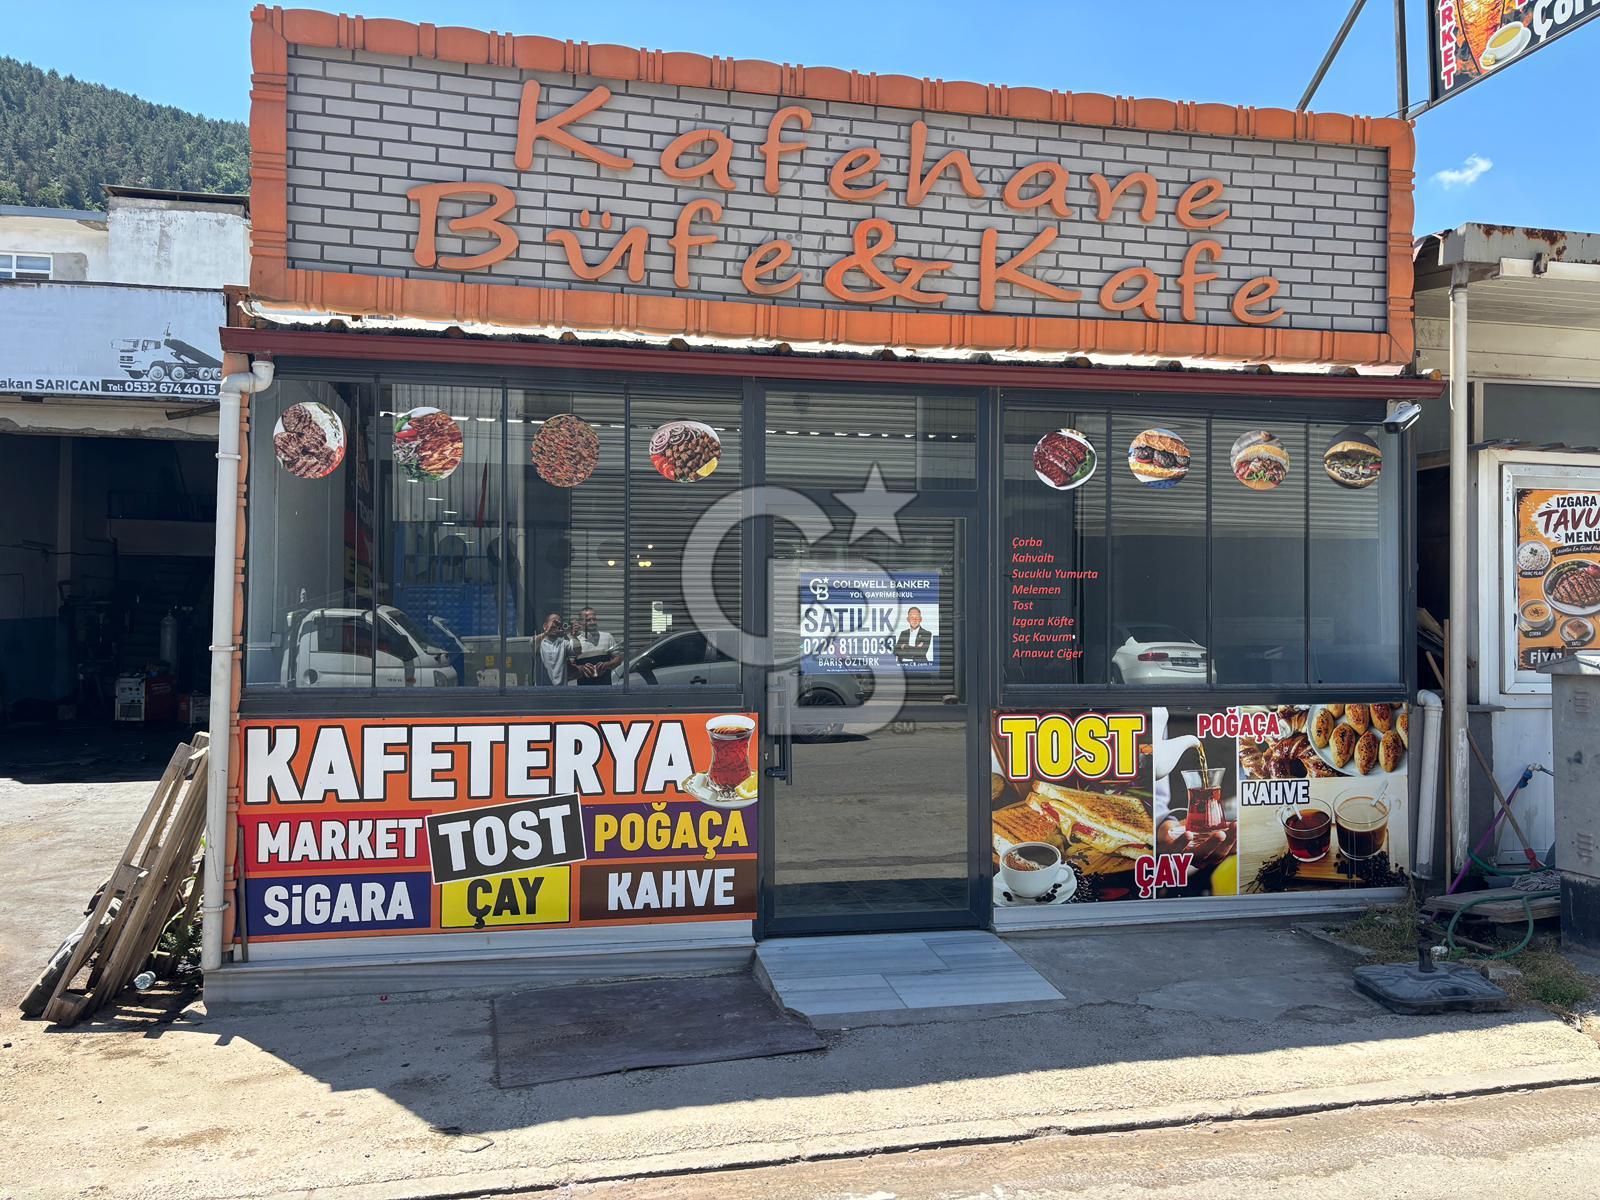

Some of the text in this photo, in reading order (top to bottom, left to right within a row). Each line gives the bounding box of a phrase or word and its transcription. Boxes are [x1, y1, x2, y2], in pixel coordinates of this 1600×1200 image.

[514, 79, 1230, 230] Kafehane
[35, 379, 100, 392] SARICAN
[107, 383, 123, 392] Tel:
[125, 382, 157, 392] 0532
[160, 383, 184, 393] 674
[184, 385, 201, 394] 40
[203, 385, 217, 394] 15
[1557, 496, 1598, 508] IZGARA
[1012, 537, 1043, 548] Çorba
[1565, 528, 1600, 543] MENÜ
[1012, 569, 1098, 579] Sucuklu Yumurta
[833, 580, 930, 589] COLDWELL BANKER
[1012, 585, 1061, 594] Melemen
[1013, 601, 1034, 610] Tost
[804, 607, 894, 633] SATILIK
[1012, 616, 1074, 628] Izgara Köfte
[803, 638, 894, 655] 0226 811 0033
[1013, 633, 1030, 643] Saç
[845, 655, 880, 667] ÖZTÜRK
[1013, 649, 1083, 660] Arnavut Ciğer
[1198, 704, 1281, 743] POĞAÇA
[1000, 714, 1144, 779] TOST
[245, 720, 697, 803] KAFETERYA
[1241, 780, 1309, 806] KAHVE
[438, 804, 572, 872] TOST
[594, 802, 749, 860] POĞAÇA
[256, 817, 424, 864] MARKET
[1135, 853, 1192, 898] ÇAY
[606, 867, 736, 912] KAHVE
[466, 874, 546, 930] ÇAY
